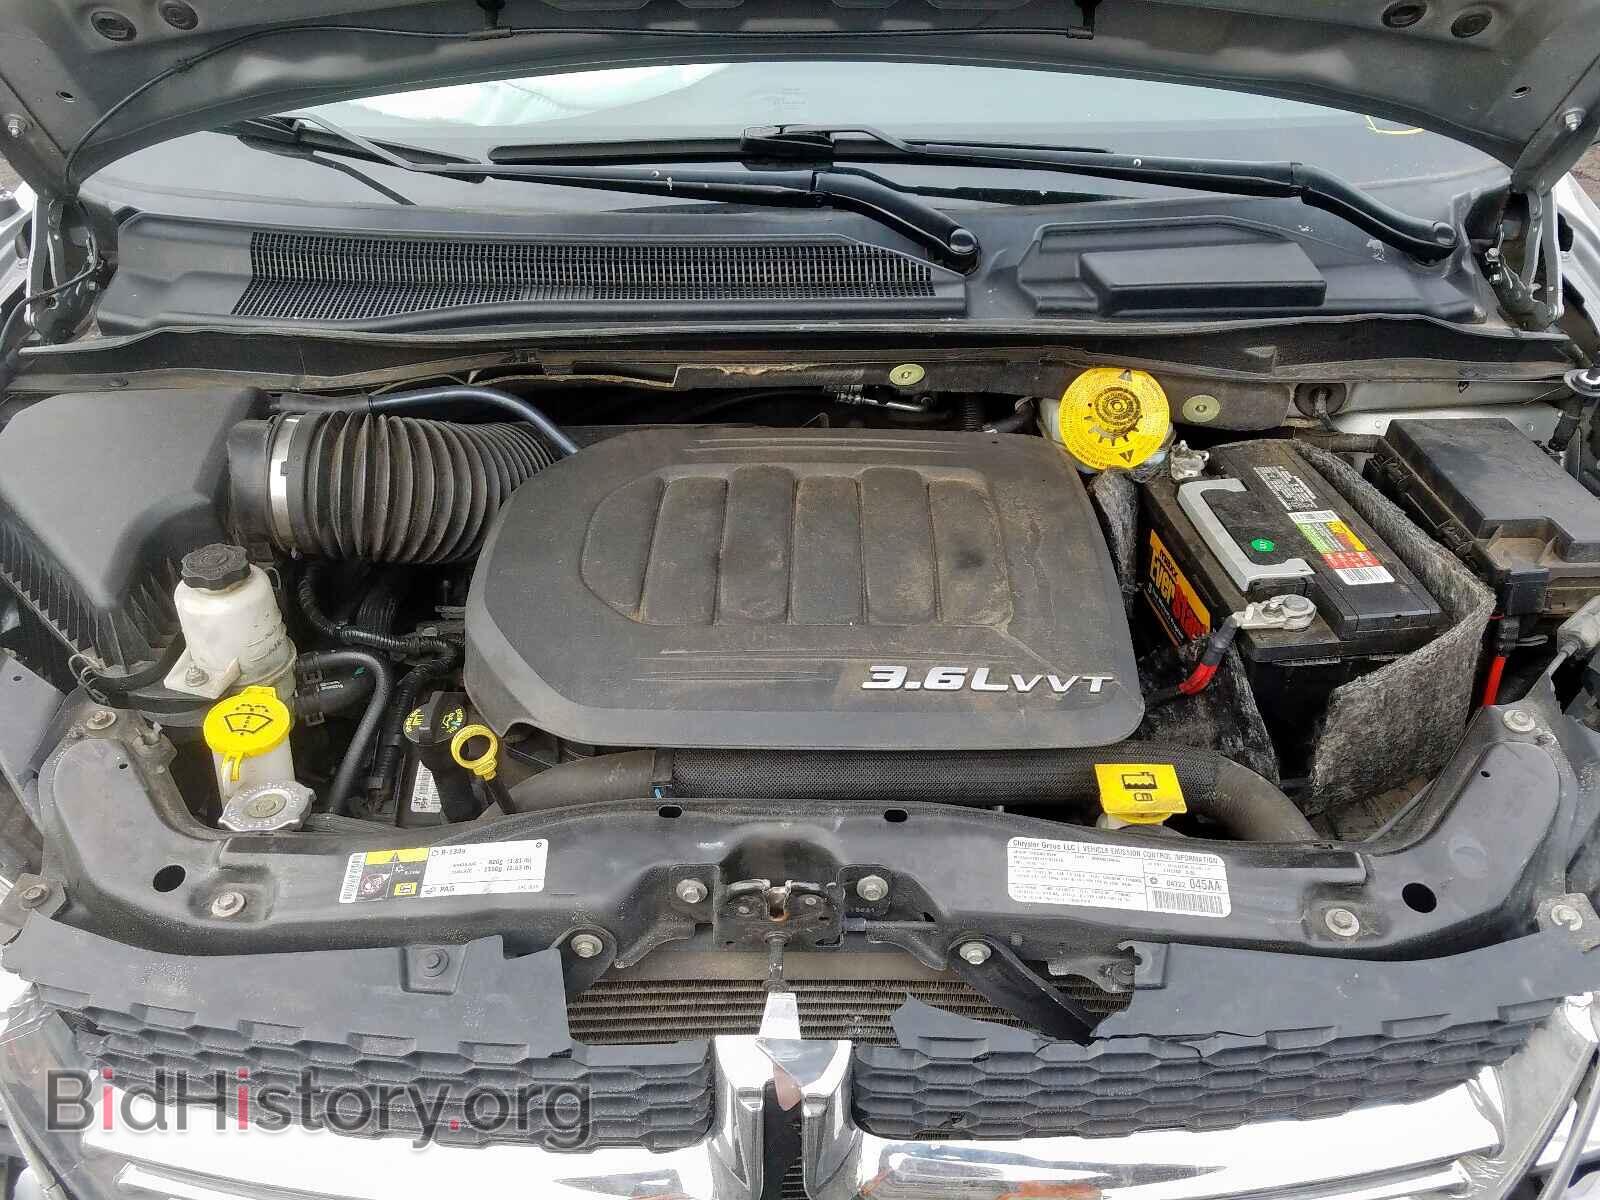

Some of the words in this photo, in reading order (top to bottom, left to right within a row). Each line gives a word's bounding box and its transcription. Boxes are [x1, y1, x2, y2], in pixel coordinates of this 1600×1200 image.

[862, 665, 1009, 691] 3.6L
[1012, 839, 1039, 849] Chrysler
[1063, 842, 1076, 851] LLC
[1082, 845, 1109, 854] VEHICLE
[1110, 847, 1141, 857] EMISSION
[1142, 850, 1172, 860] CONTROL
[1174, 853, 1219, 864] INFORMATION
[439, 885, 455, 893] PAG
